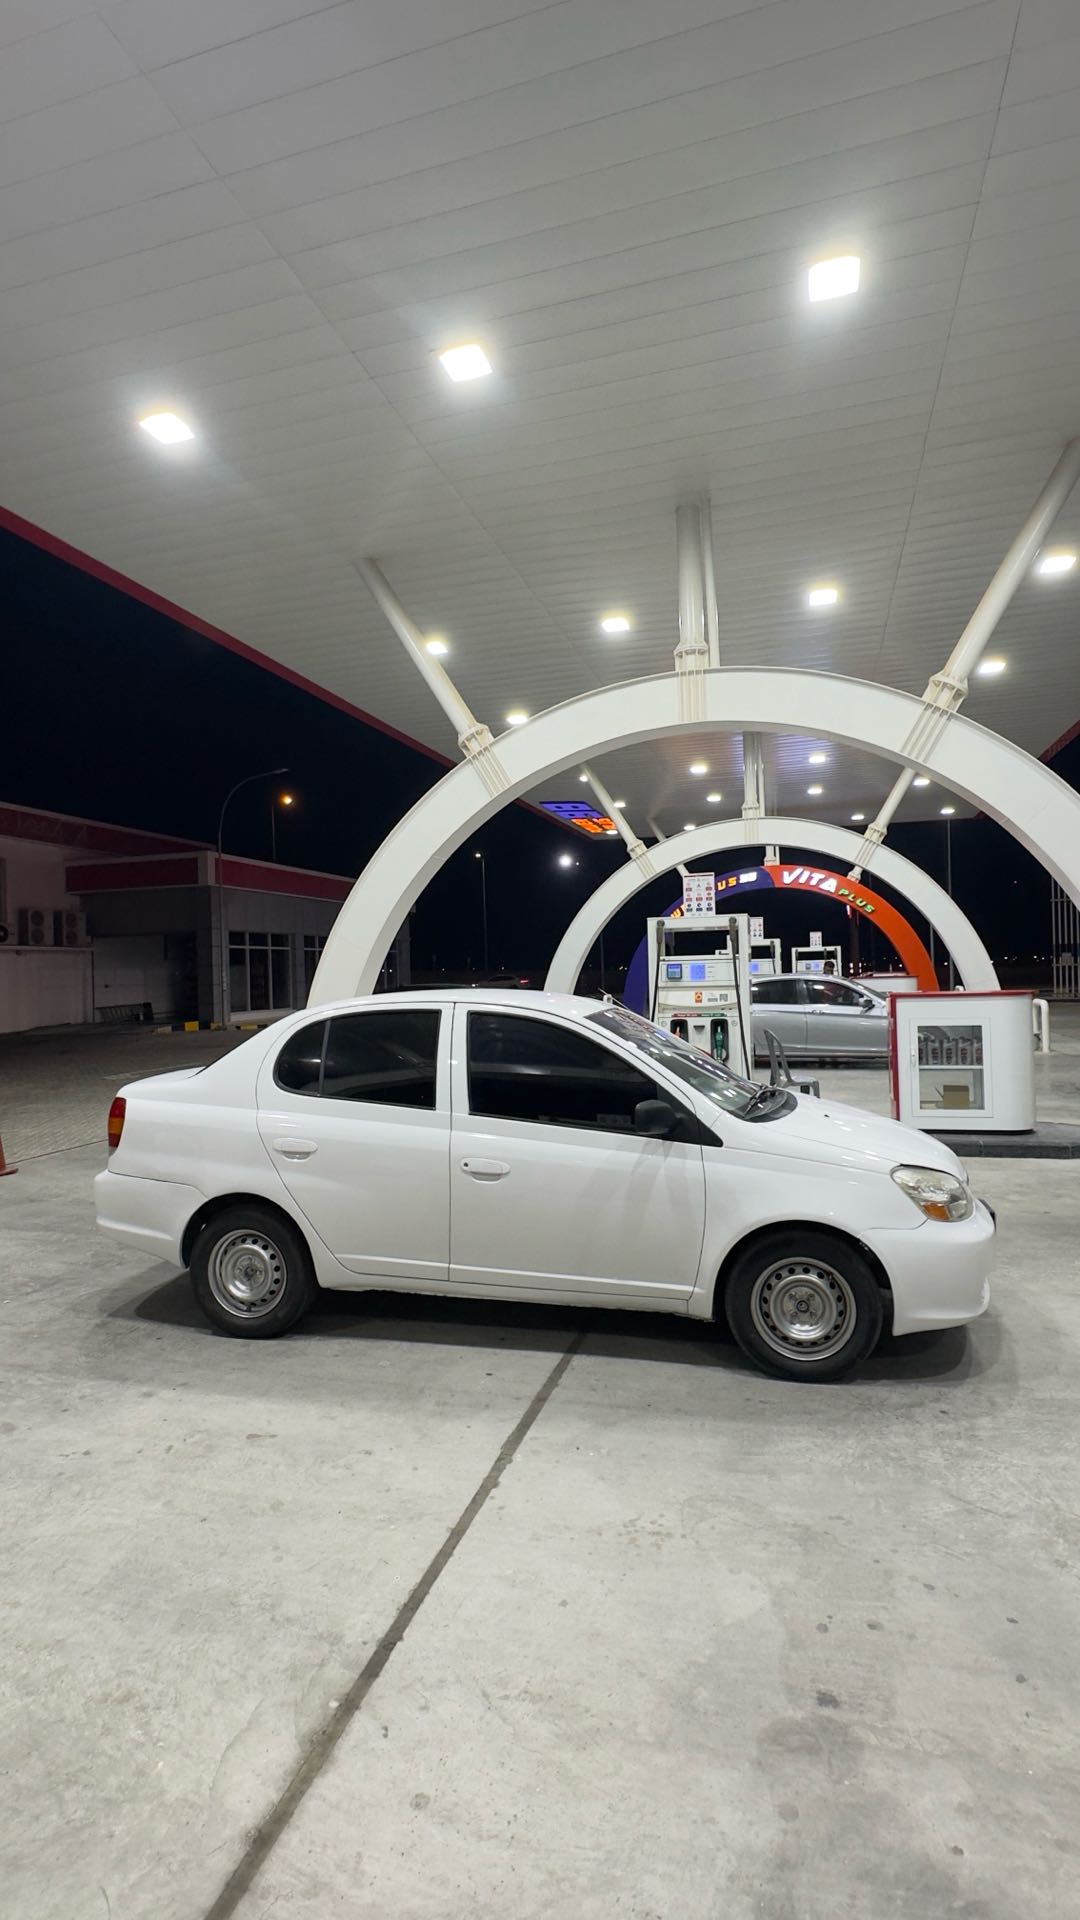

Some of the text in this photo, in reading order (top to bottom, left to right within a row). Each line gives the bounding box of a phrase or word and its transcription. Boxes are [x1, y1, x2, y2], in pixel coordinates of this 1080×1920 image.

[717, 876, 737, 891] US
[782, 867, 837, 893] VITA
[838, 888, 875, 913] PLUS
